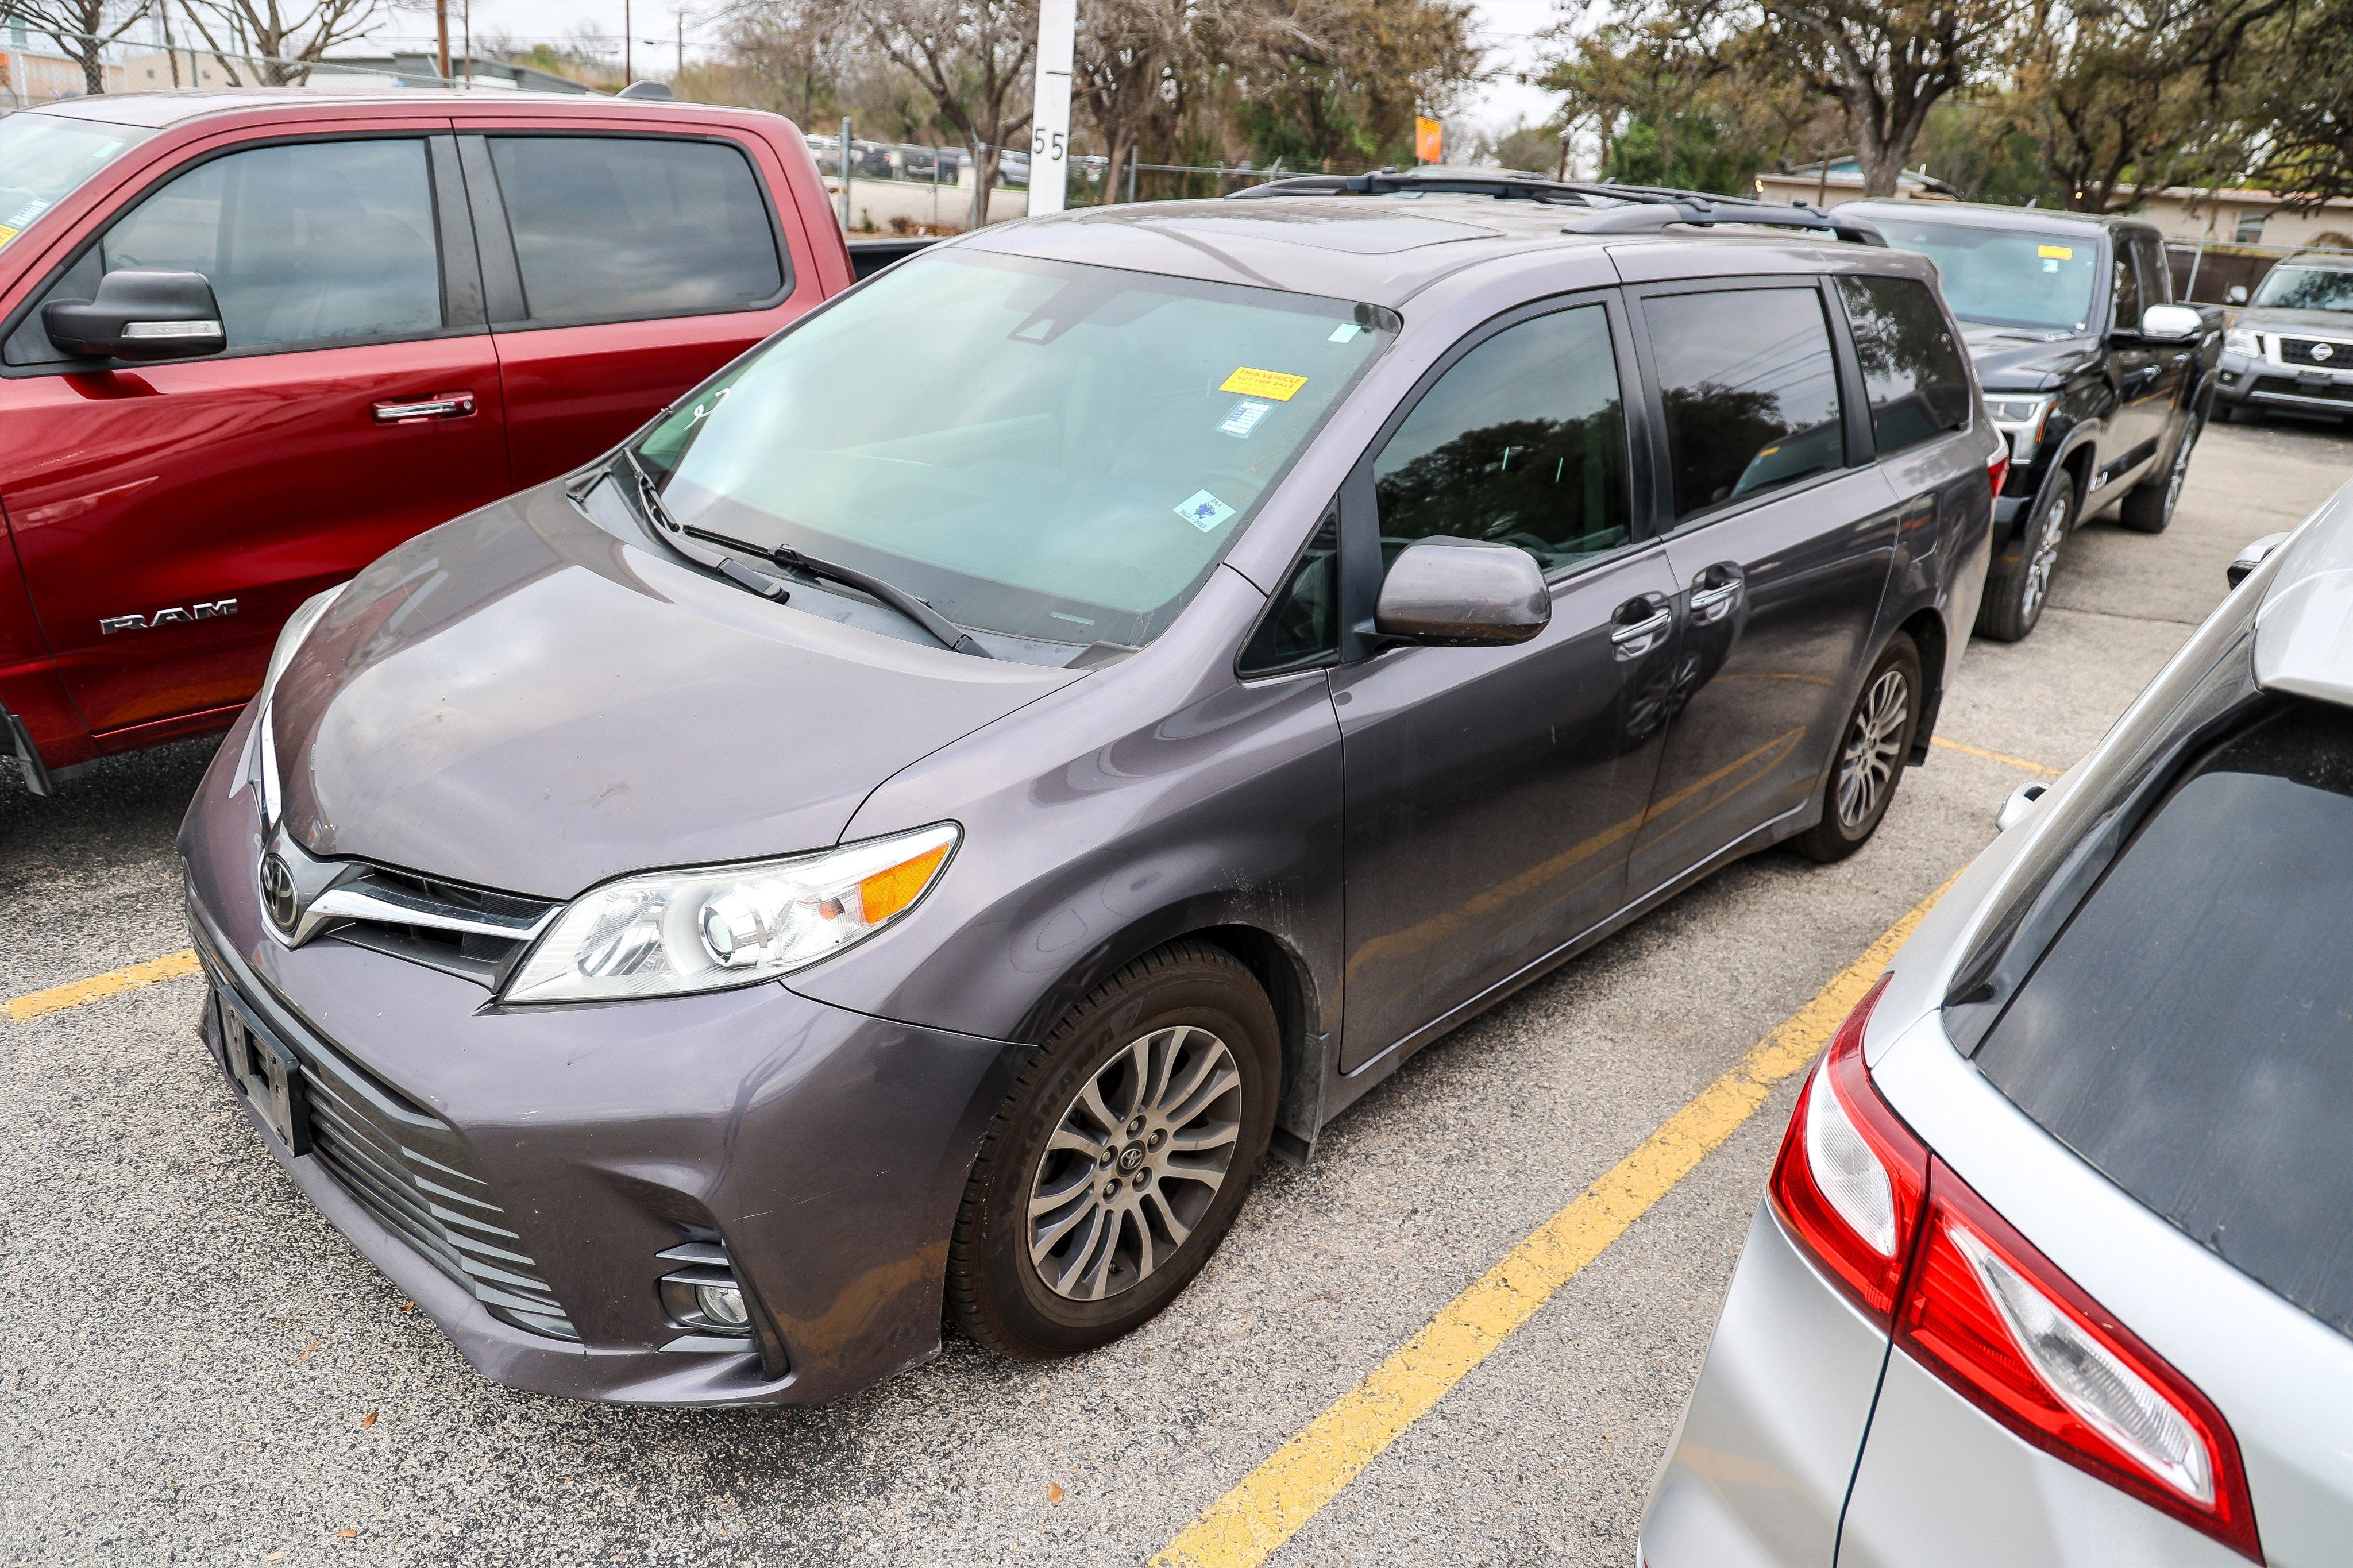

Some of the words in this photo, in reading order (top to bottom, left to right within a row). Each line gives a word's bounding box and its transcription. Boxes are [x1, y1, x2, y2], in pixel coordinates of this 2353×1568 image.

[1032, 126, 1065, 161] 55
[1263, 372, 1303, 384] VEHICLE
[1210, 498, 1222, 508] SAA
[1179, 509, 1193, 519] 2024
[1194, 519, 1207, 529] 2025
[99, 598, 238, 635] RAM
[998, 1025, 1116, 1219] YOKOHAMA
